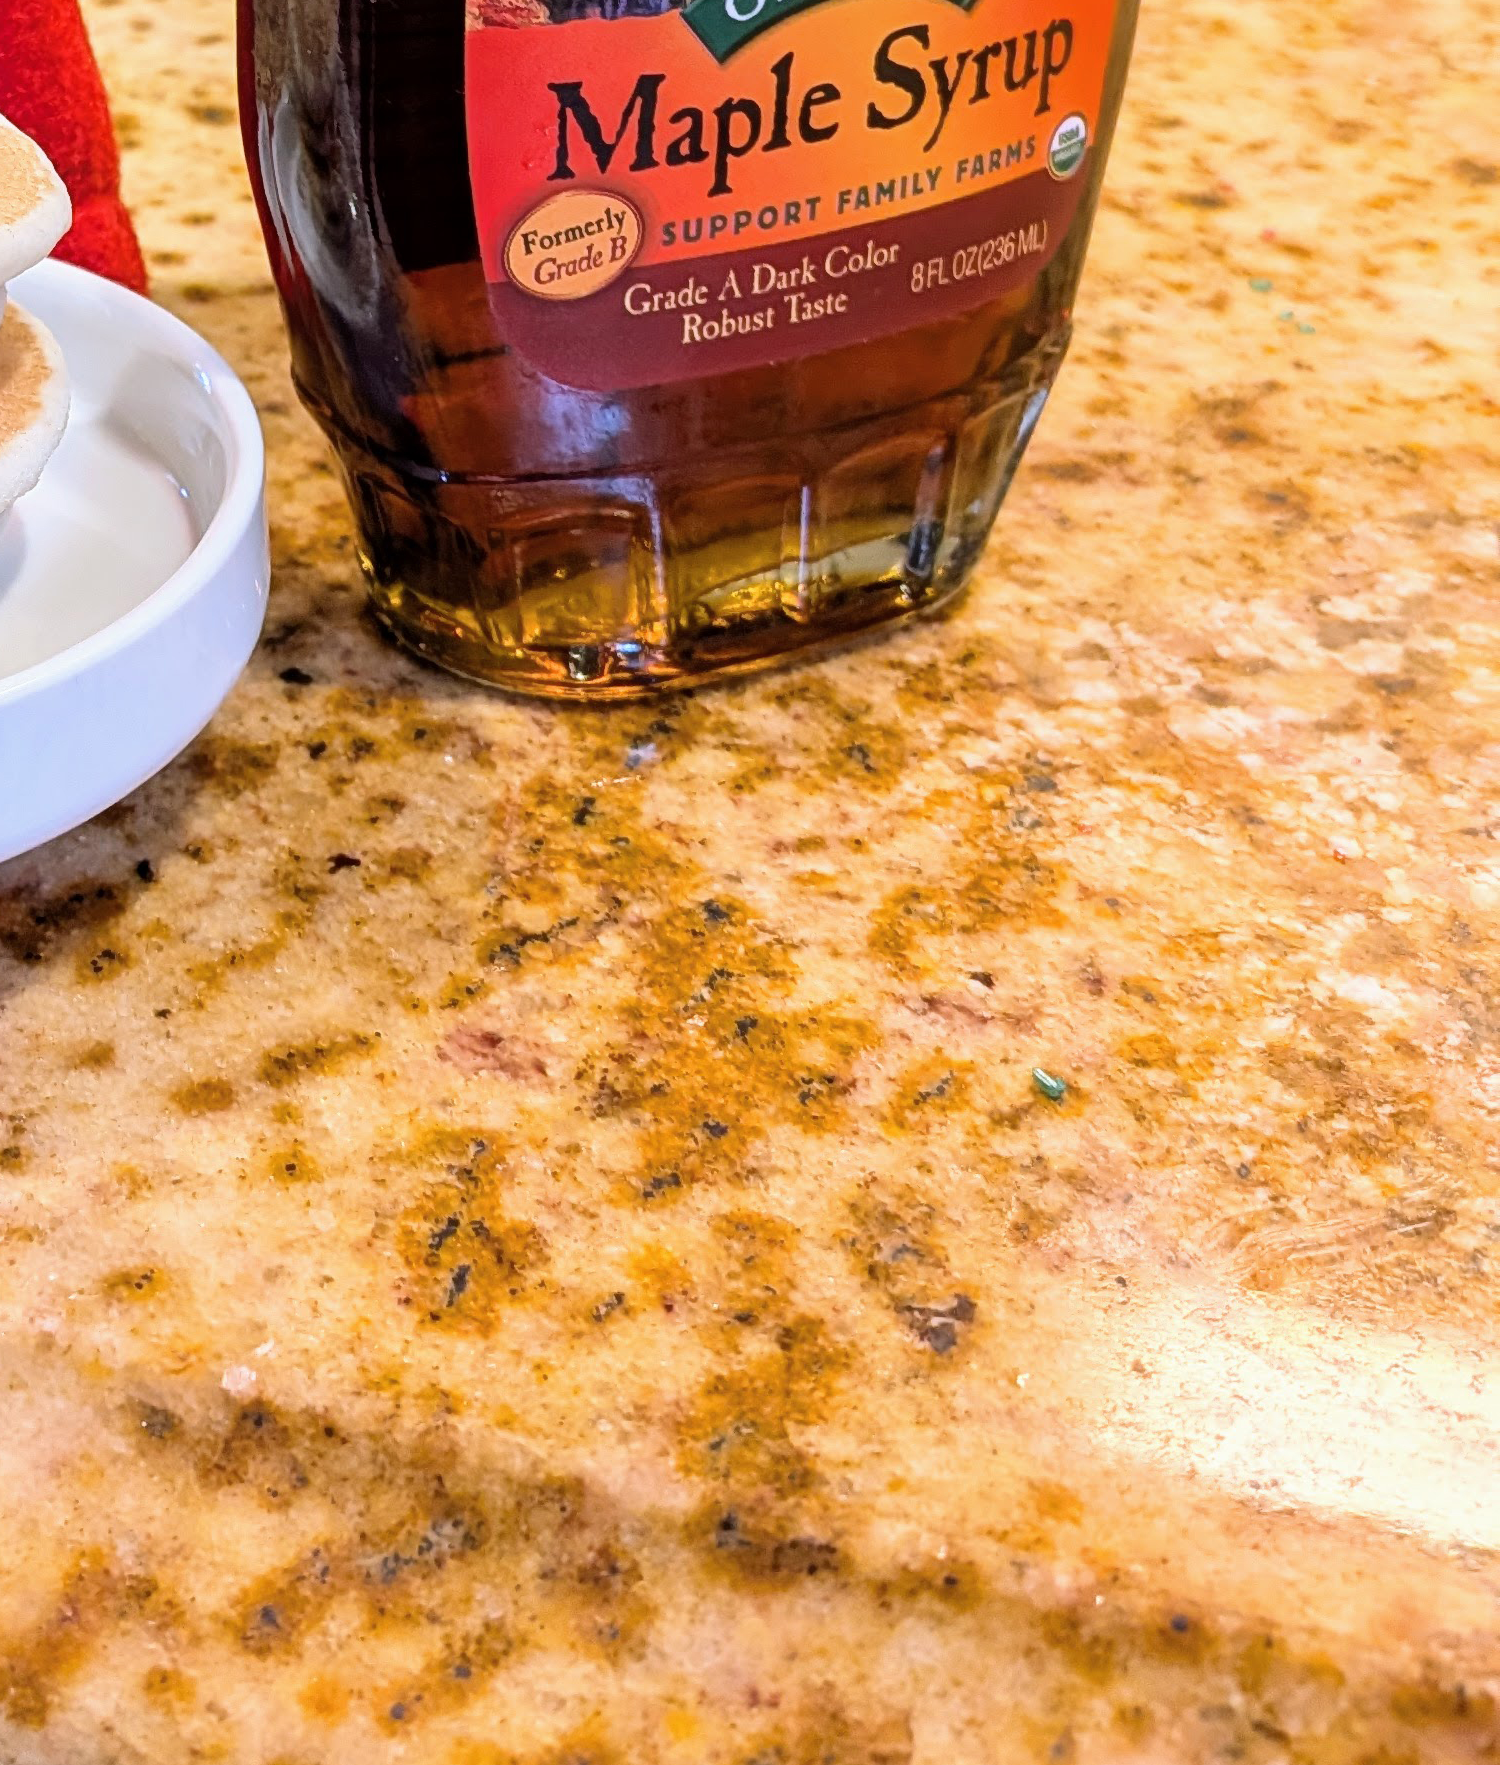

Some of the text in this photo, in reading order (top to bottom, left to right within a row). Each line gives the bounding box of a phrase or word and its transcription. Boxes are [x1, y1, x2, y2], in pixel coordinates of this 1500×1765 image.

[546, 18, 1074, 198] Maple Syrup
[661, 136, 1036, 246] SUPPORT FAMILY FARMS
[521, 207, 626, 256] Formerly
[534, 235, 627, 285] Grade B
[624, 240, 900, 315] Grade A Dark Color
[681, 290, 849, 345] Robust Taste
